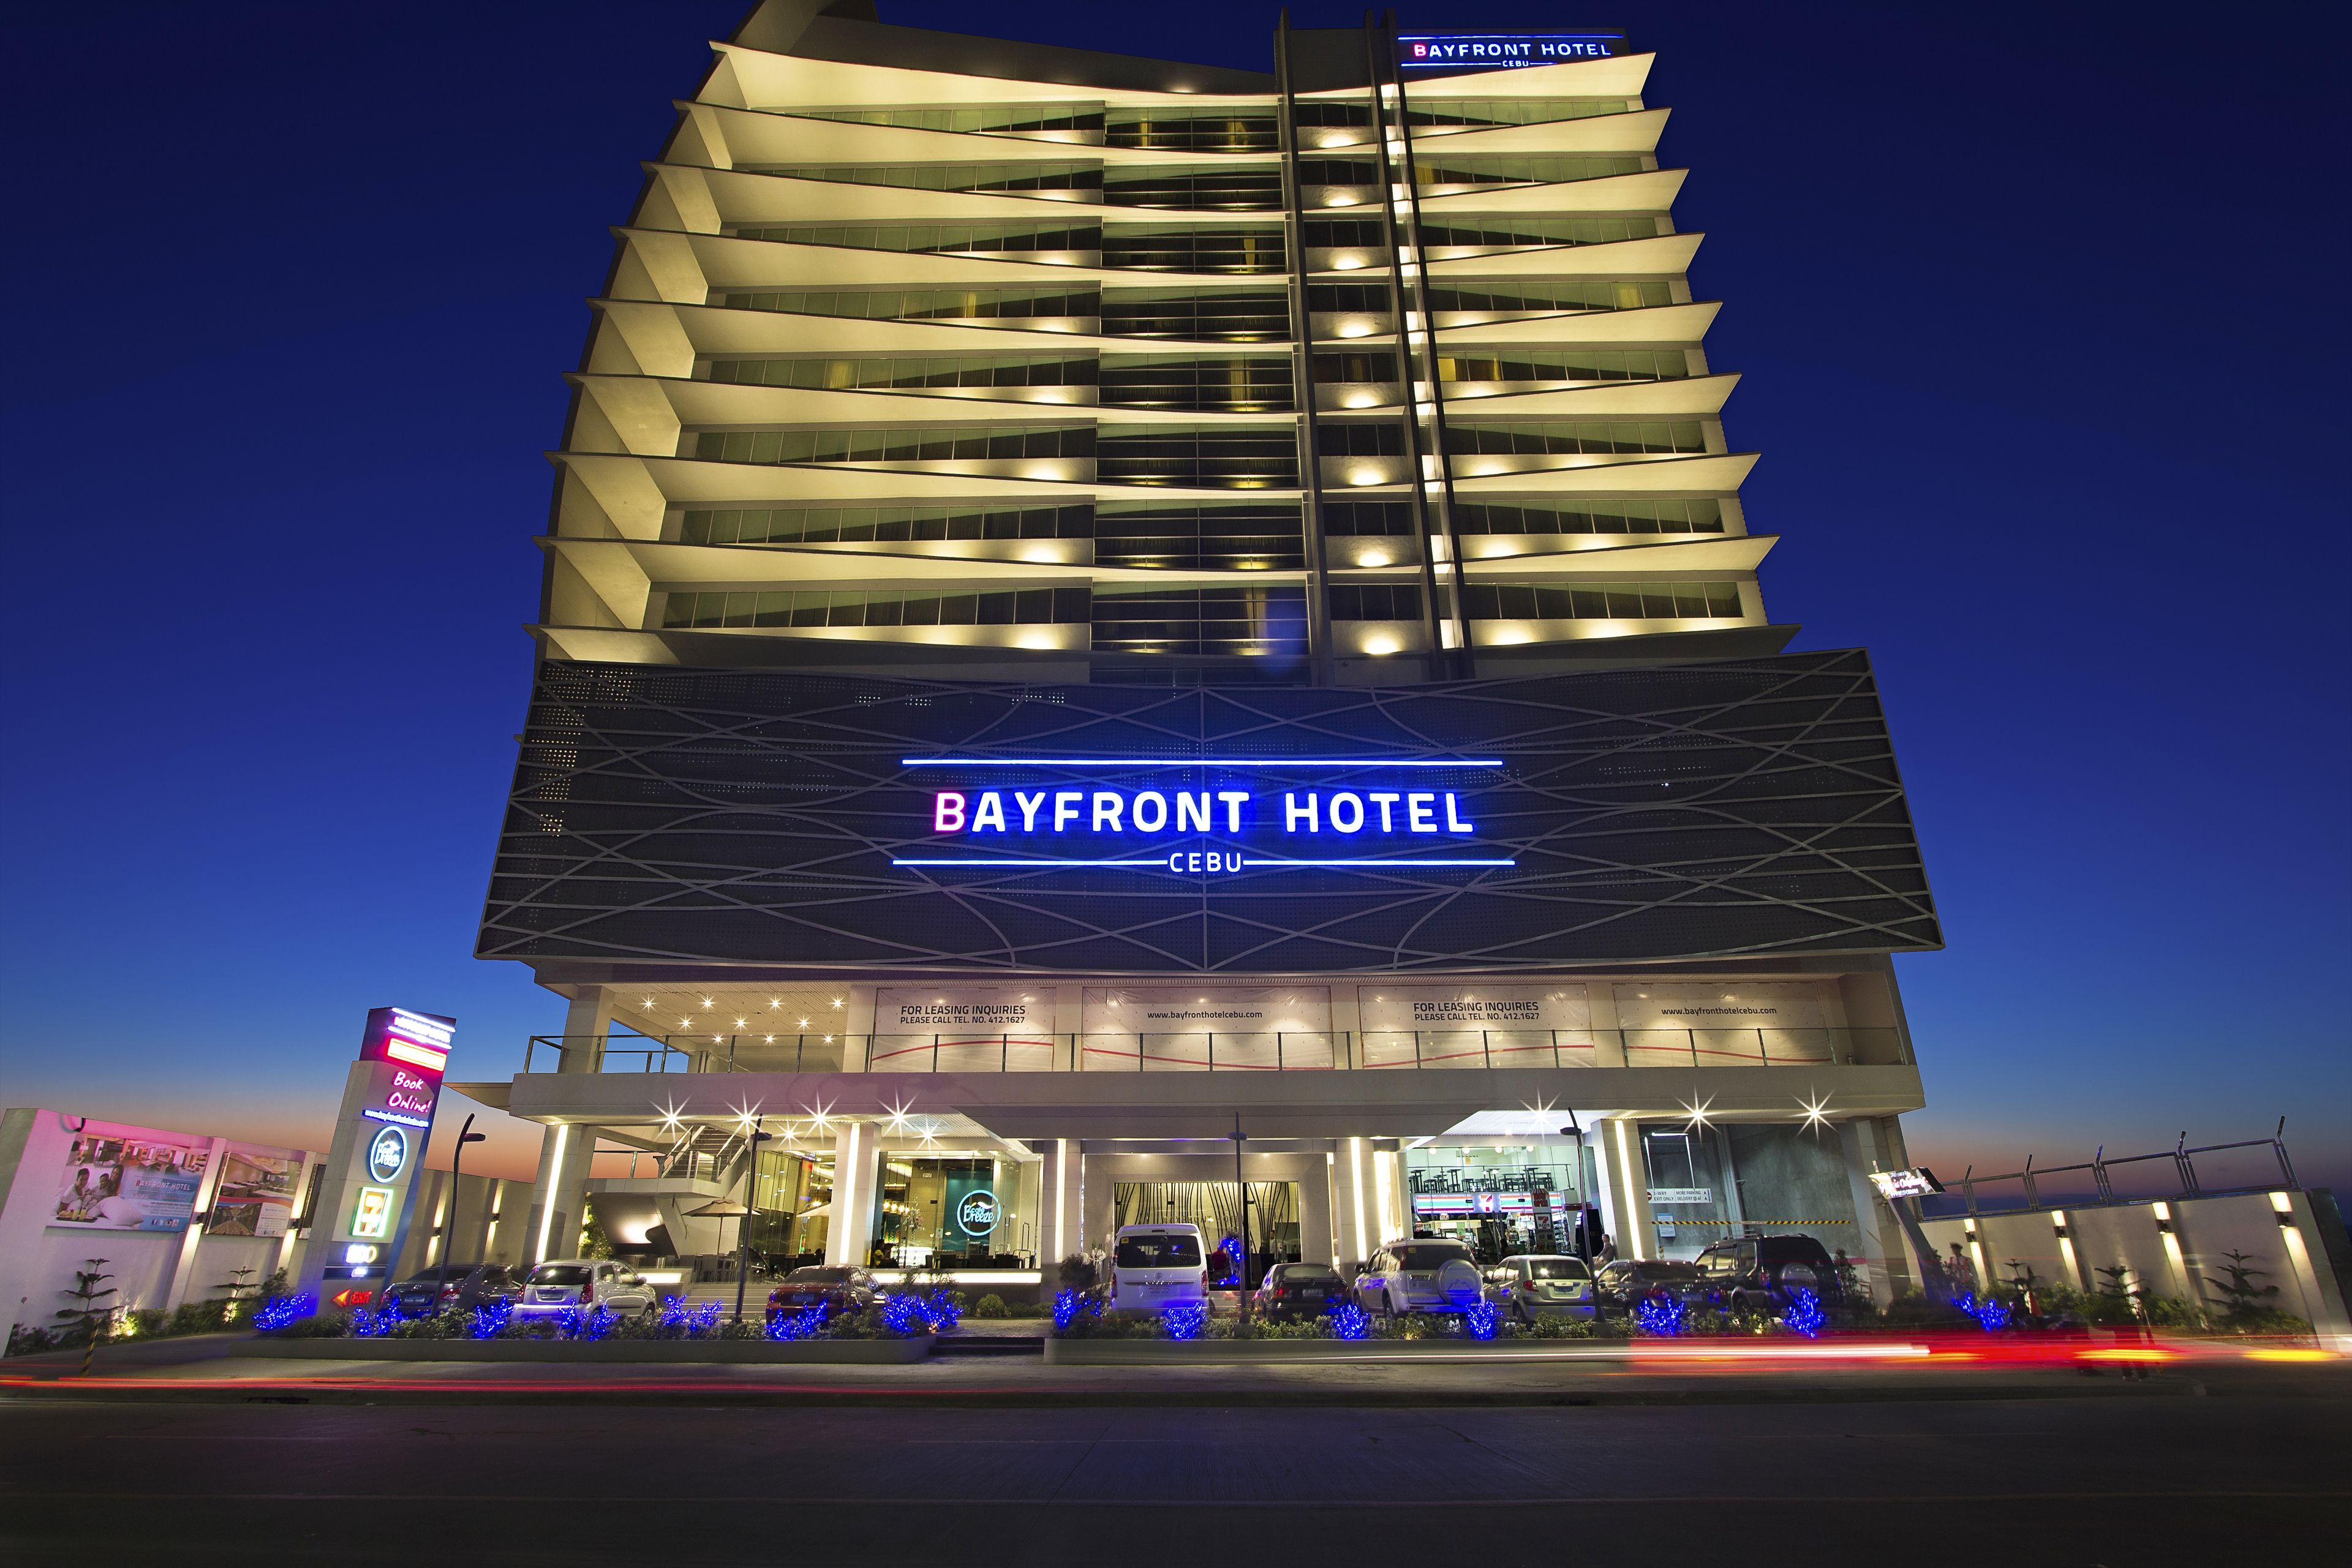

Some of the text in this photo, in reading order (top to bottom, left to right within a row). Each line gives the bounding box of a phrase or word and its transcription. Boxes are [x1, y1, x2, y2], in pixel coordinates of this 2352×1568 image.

[1414, 43, 1611, 57] BAYFRONT HOTEL
[934, 790, 1473, 834] BAYFRONT HOTEL
[1169, 852, 1242, 873] CEBU
[901, 1006, 1025, 1016] FOR LEASING INQUIRIES
[1414, 1001, 1539, 1012] FOR LEASING INQUIRIES
[1662, 1007, 1777, 1016] www.bayfronthotelcebu.com
[1147, 1011, 1262, 1020] www.bayfronthotelcebu.com
[393, 1071, 424, 1090] Book
[388, 1092, 432, 1113] Online!
[136, 1180, 170, 1188] BAYFRONT
[963, 1205, 995, 1223] Breeze
[350, 1291, 372, 1304] EXIT
